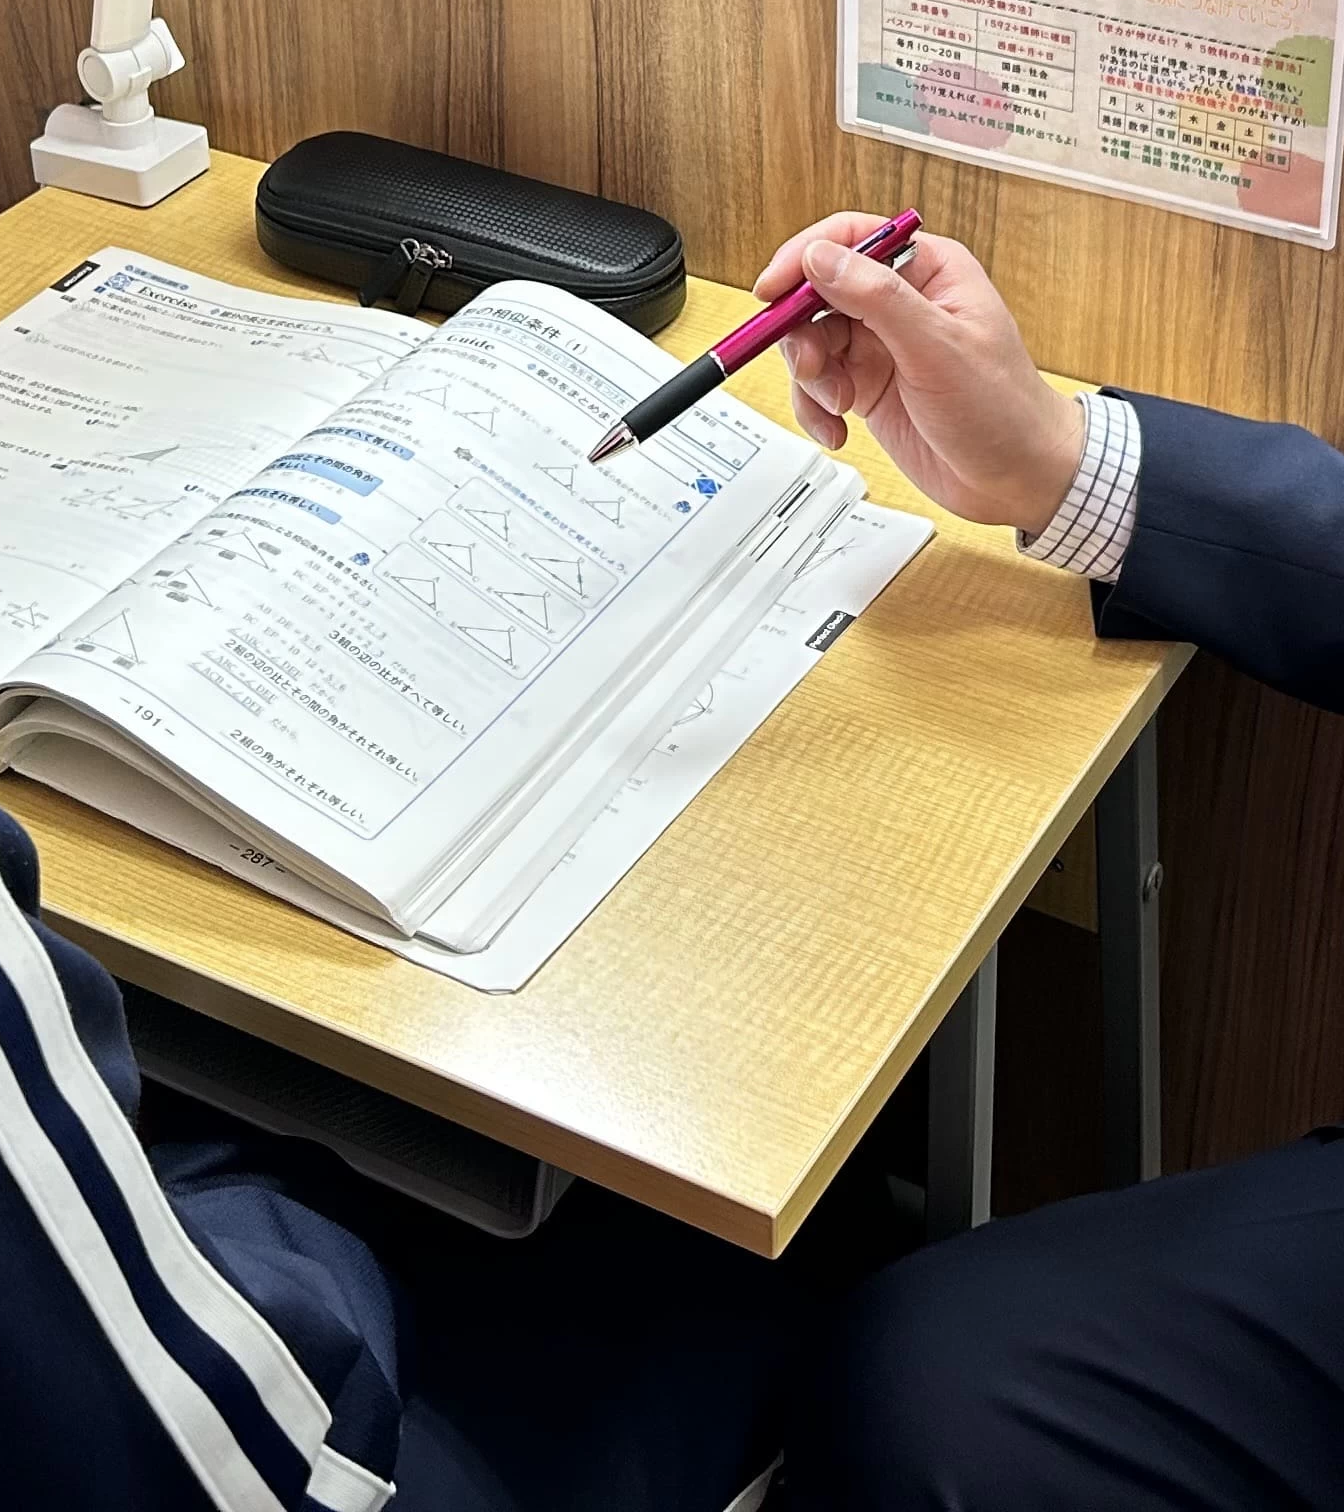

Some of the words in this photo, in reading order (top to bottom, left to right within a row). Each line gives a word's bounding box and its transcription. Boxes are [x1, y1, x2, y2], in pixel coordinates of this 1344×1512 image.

[137, 286, 198, 310] Exercise
[229, 728, 366, 824] 2組の角がそれぞれ等しい。
